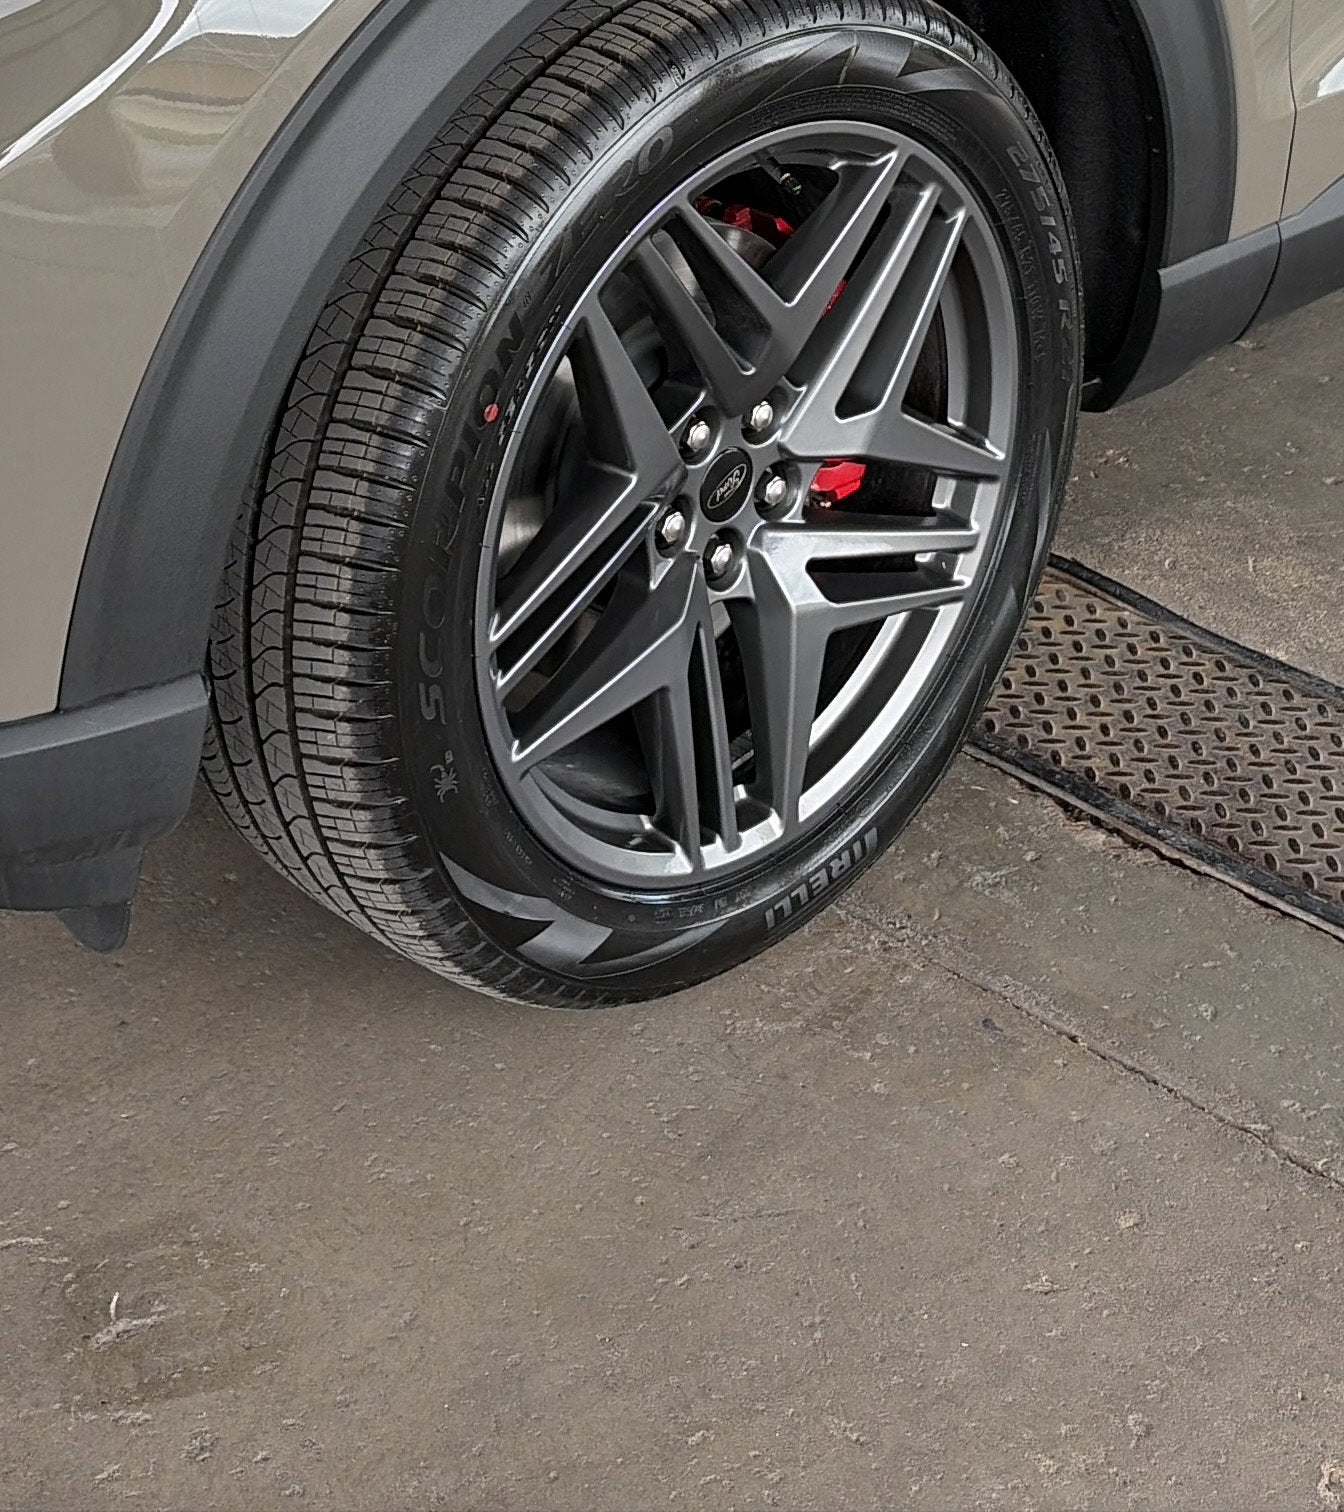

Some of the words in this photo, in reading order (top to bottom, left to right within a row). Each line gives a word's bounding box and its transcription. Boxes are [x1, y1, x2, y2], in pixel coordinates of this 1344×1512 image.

[1006, 140, 1069, 285] 275/45
[419, 311, 525, 725] SCORPION
[716, 469, 741, 503] Ford
